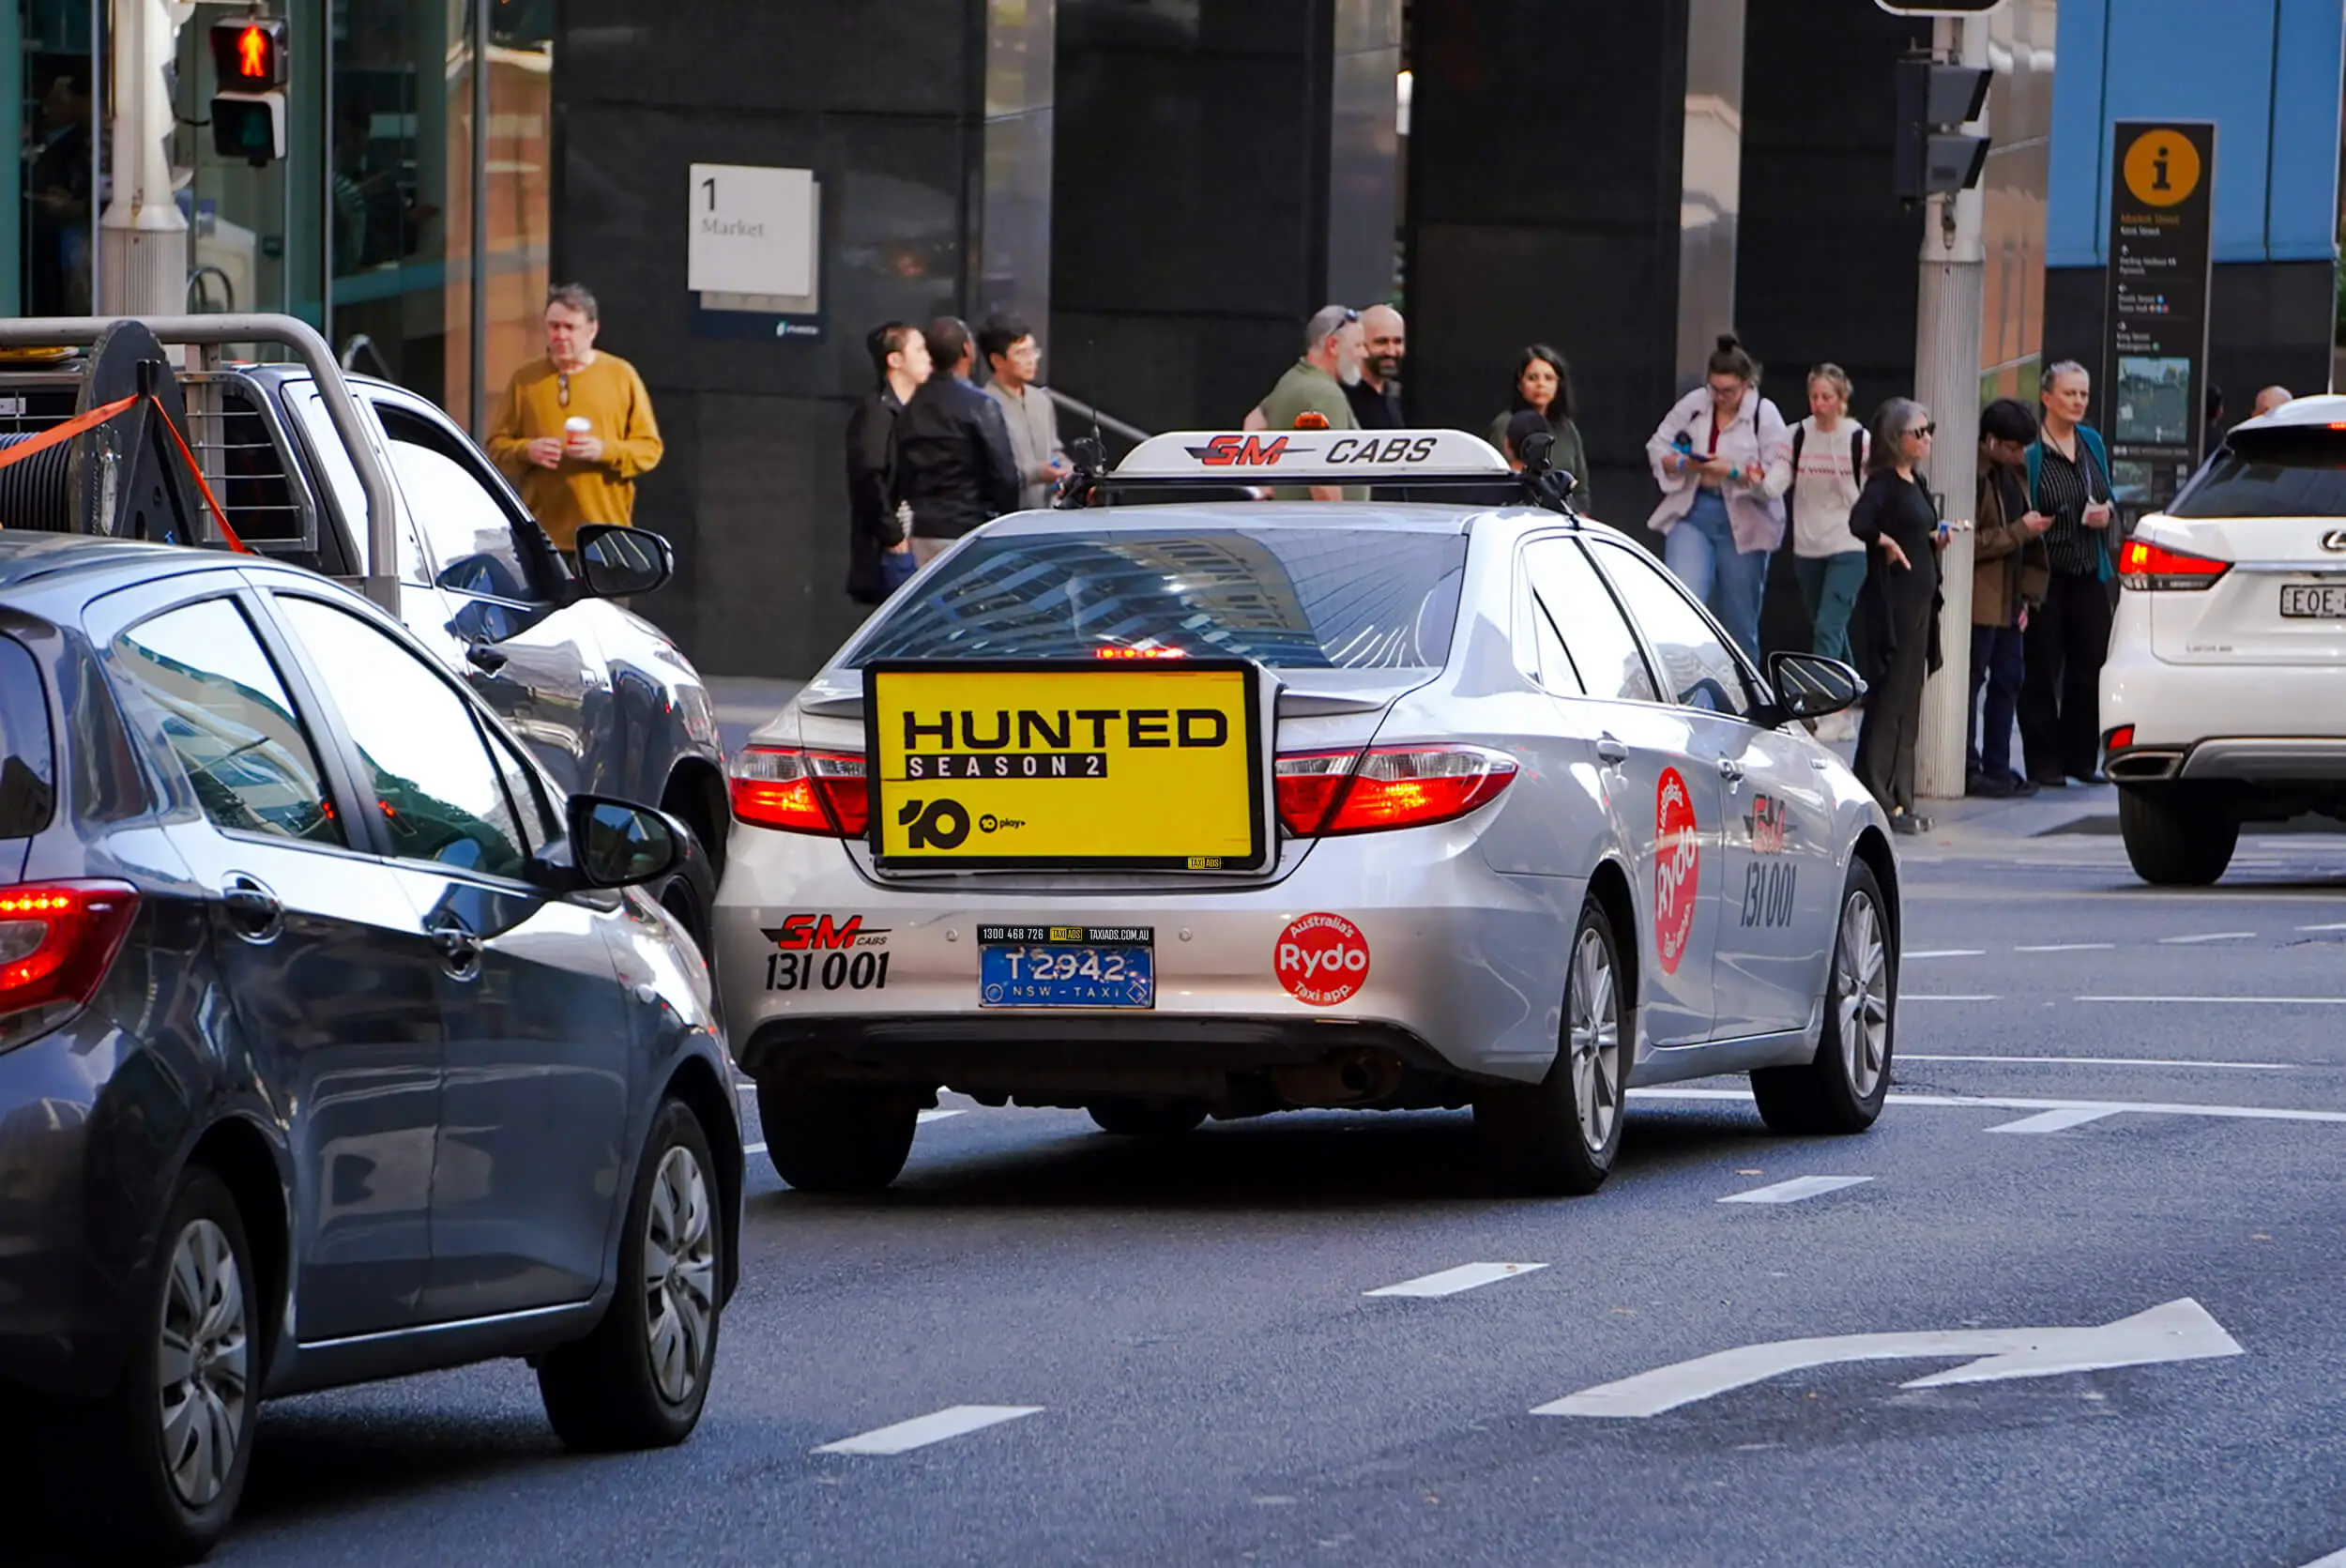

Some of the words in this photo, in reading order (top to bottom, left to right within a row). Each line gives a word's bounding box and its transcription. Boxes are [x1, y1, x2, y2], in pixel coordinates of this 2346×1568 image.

[701, 177, 716, 212] 1
[701, 219, 766, 238] Market
[1324, 436, 1439, 464] CABS
[902, 708, 1228, 750] HUNTED
[908, 755, 1068, 778] SEASON
[1085, 755, 1101, 777] 2
[898, 799, 971, 850] 10
[1656, 825, 1697, 922] Rydo
[1740, 861, 1767, 928] 131
[1765, 861, 1798, 929] 001
[856, 936, 888, 946] CABS
[983, 928, 1004, 939] 1300
[1007, 928, 1024, 939] 468
[1028, 928, 1044, 939] 726
[1089, 929, 1150, 941] TAXIADS.COM.AU
[1289, 915, 1356, 939] Australia's
[766, 951, 814, 991] 131
[821, 951, 891, 991] 001
[1279, 942, 1367, 979] Rydo
[1294, 980, 1321, 1001] Taxi
